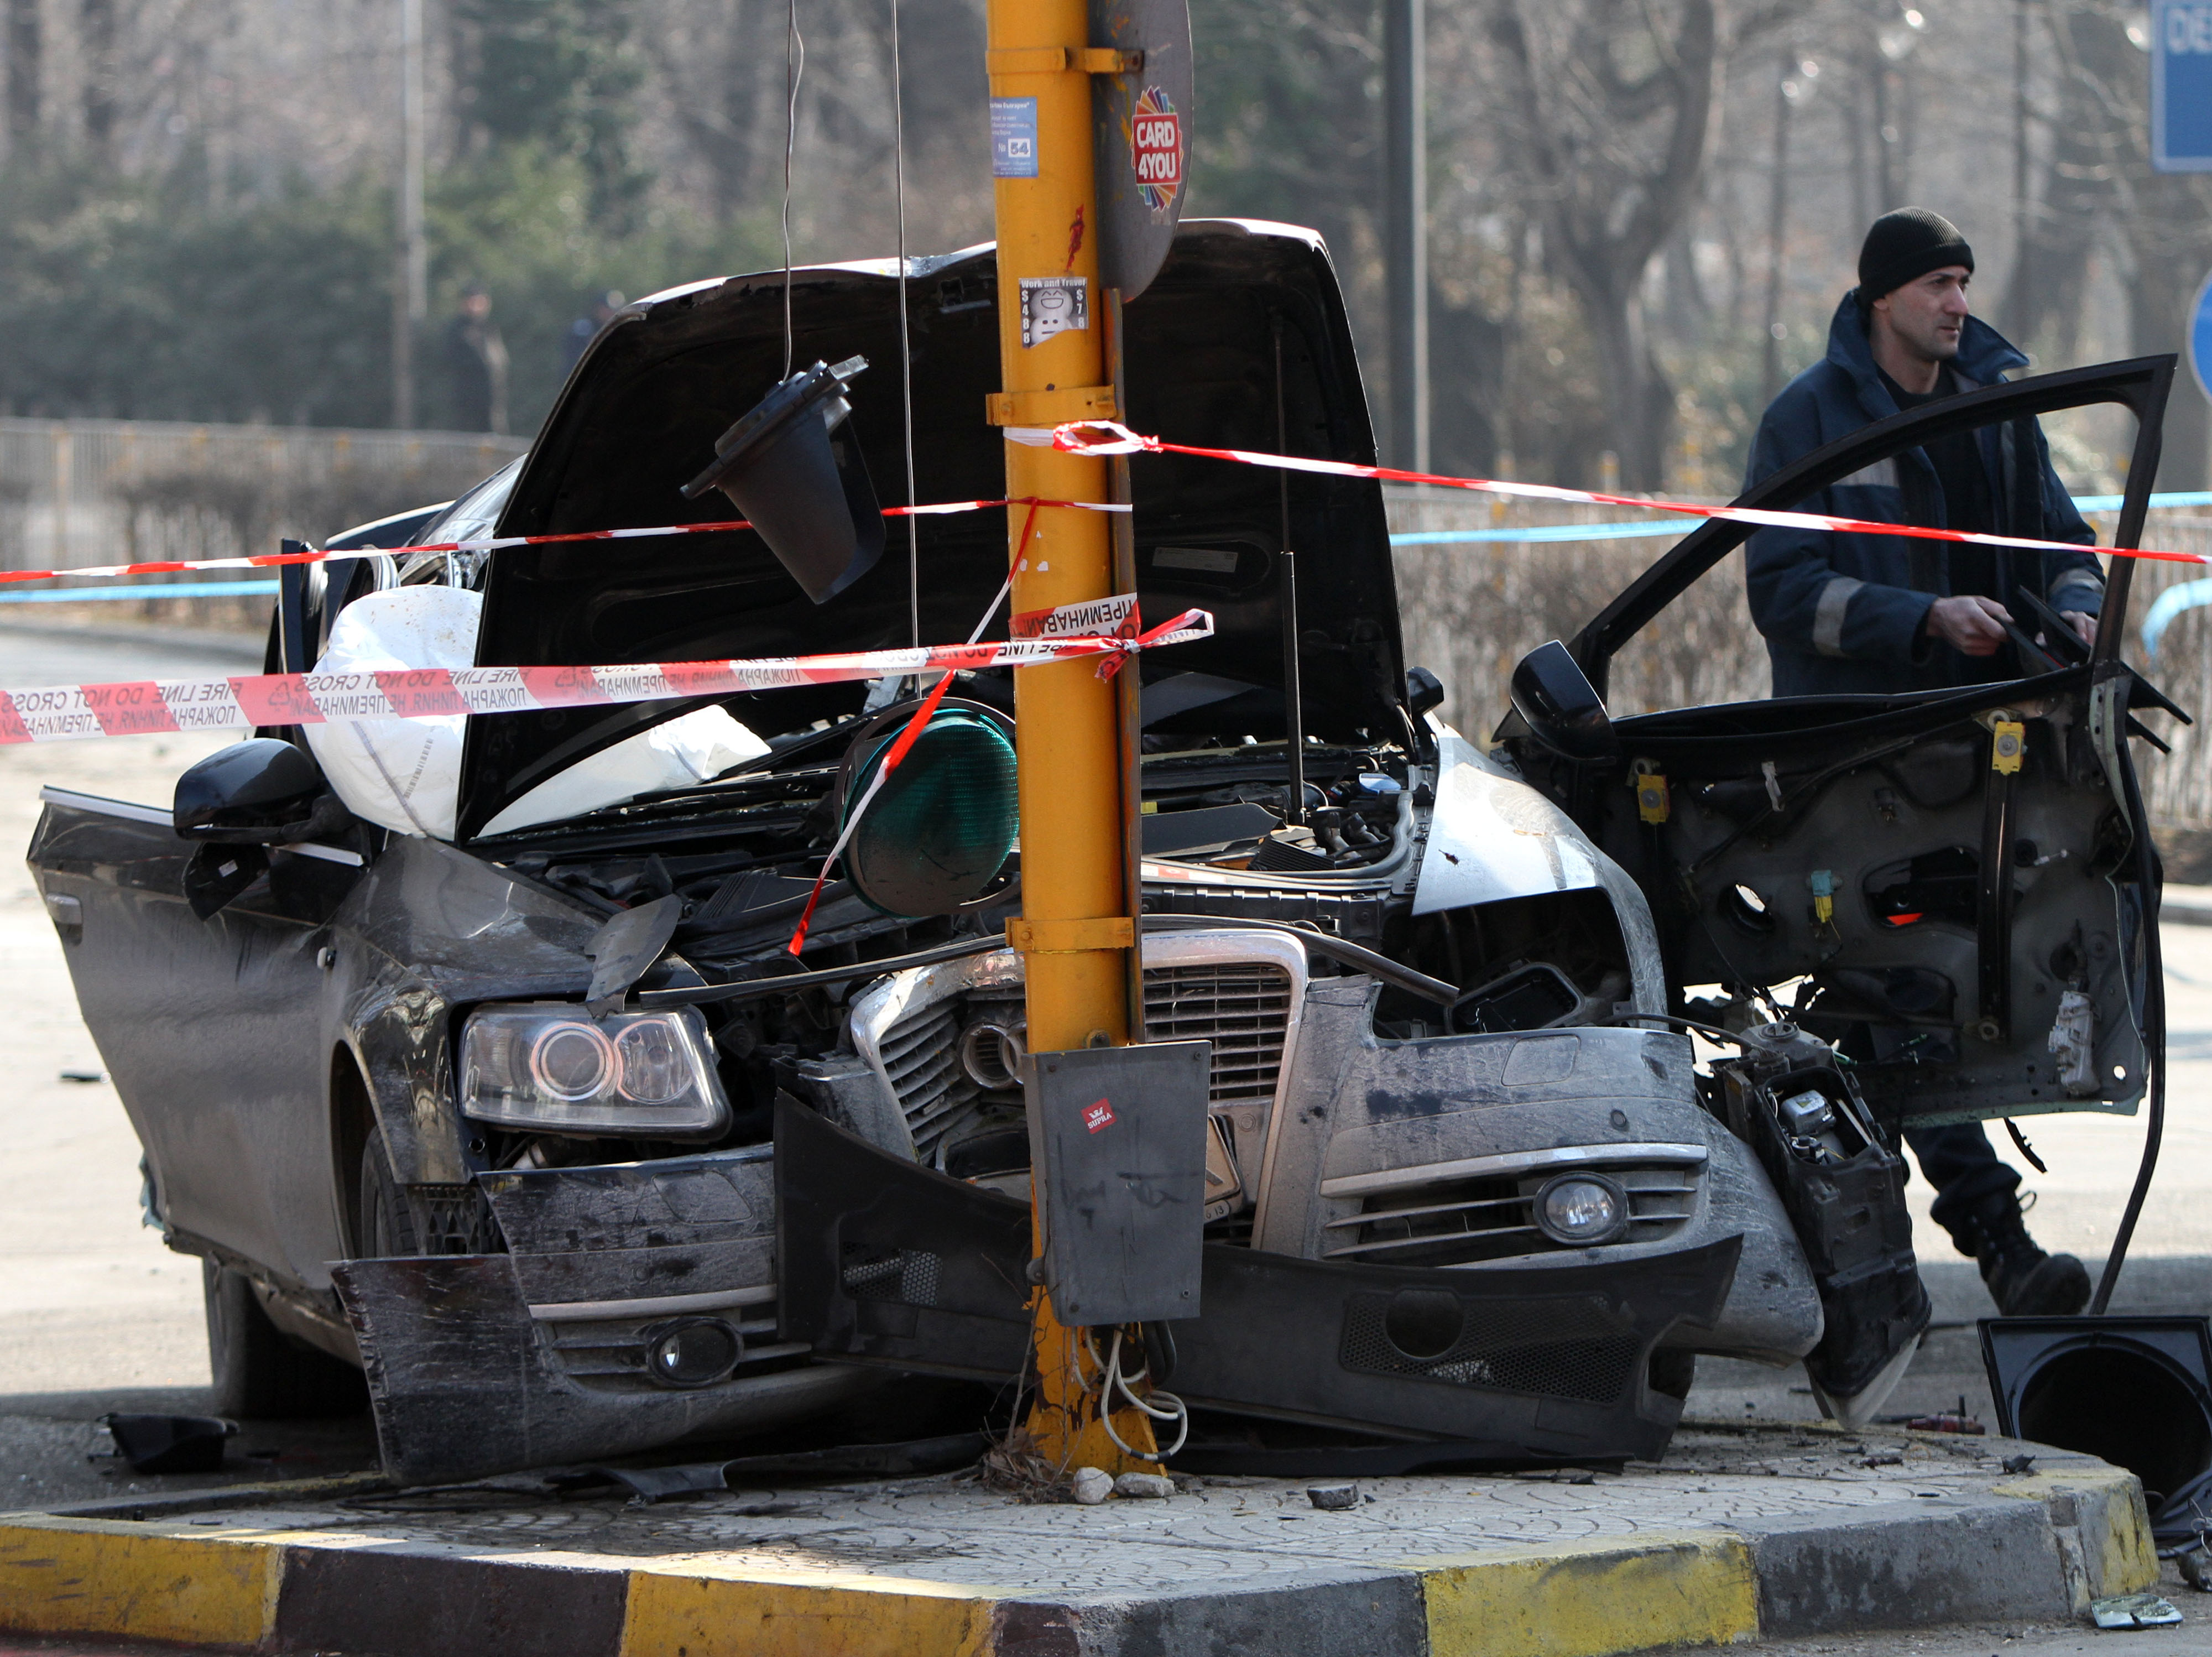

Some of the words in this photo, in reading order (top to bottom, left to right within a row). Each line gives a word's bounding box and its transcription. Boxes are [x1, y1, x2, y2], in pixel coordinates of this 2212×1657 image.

[1136, 121, 1175, 148] CARD
[1010, 142, 1029, 155] 54
[1138, 153, 1176, 179] 4YOU
[1021, 280, 1043, 288] Work
[1044, 279, 1060, 288] and
[1062, 278, 1086, 287] Travel
[1088, 1112, 1113, 1129] SUPRA
